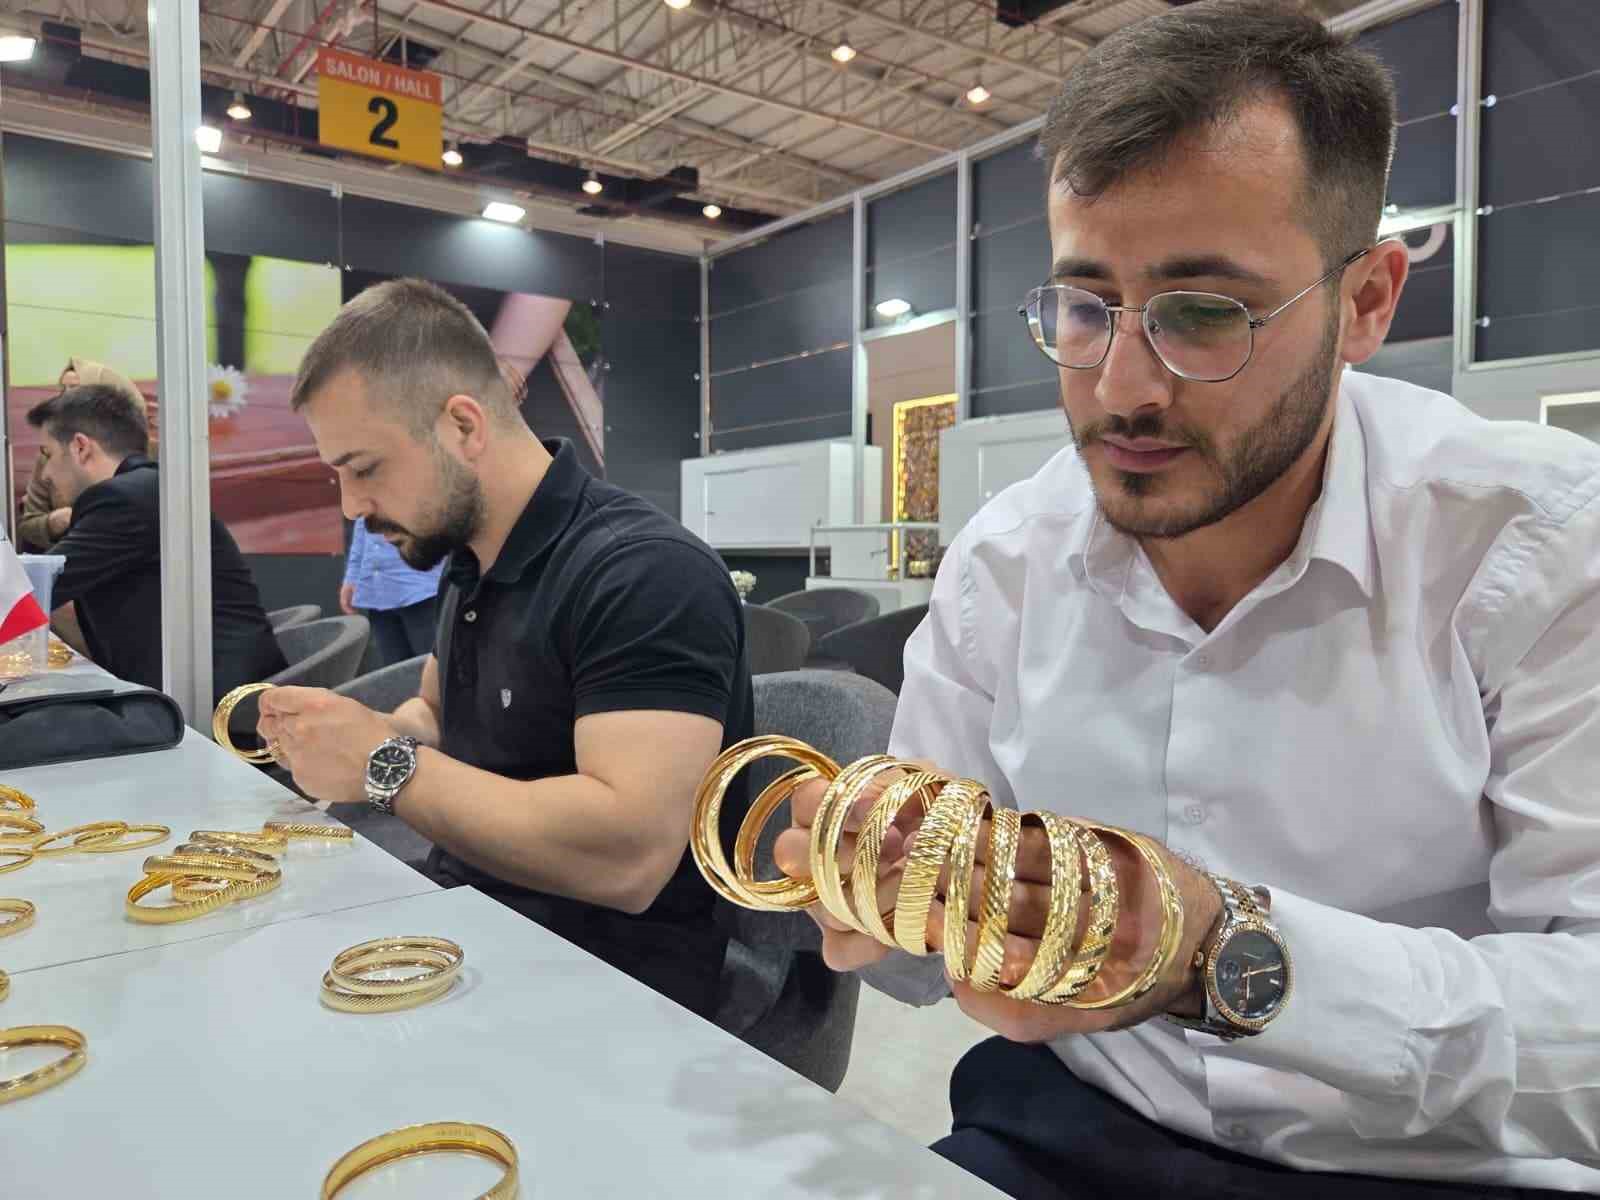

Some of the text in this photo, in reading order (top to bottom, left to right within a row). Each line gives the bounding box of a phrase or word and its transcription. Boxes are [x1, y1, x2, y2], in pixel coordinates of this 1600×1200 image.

[326, 58, 380, 86] SALON
[394, 75, 432, 99] HALL
[368, 96, 399, 149] 2
